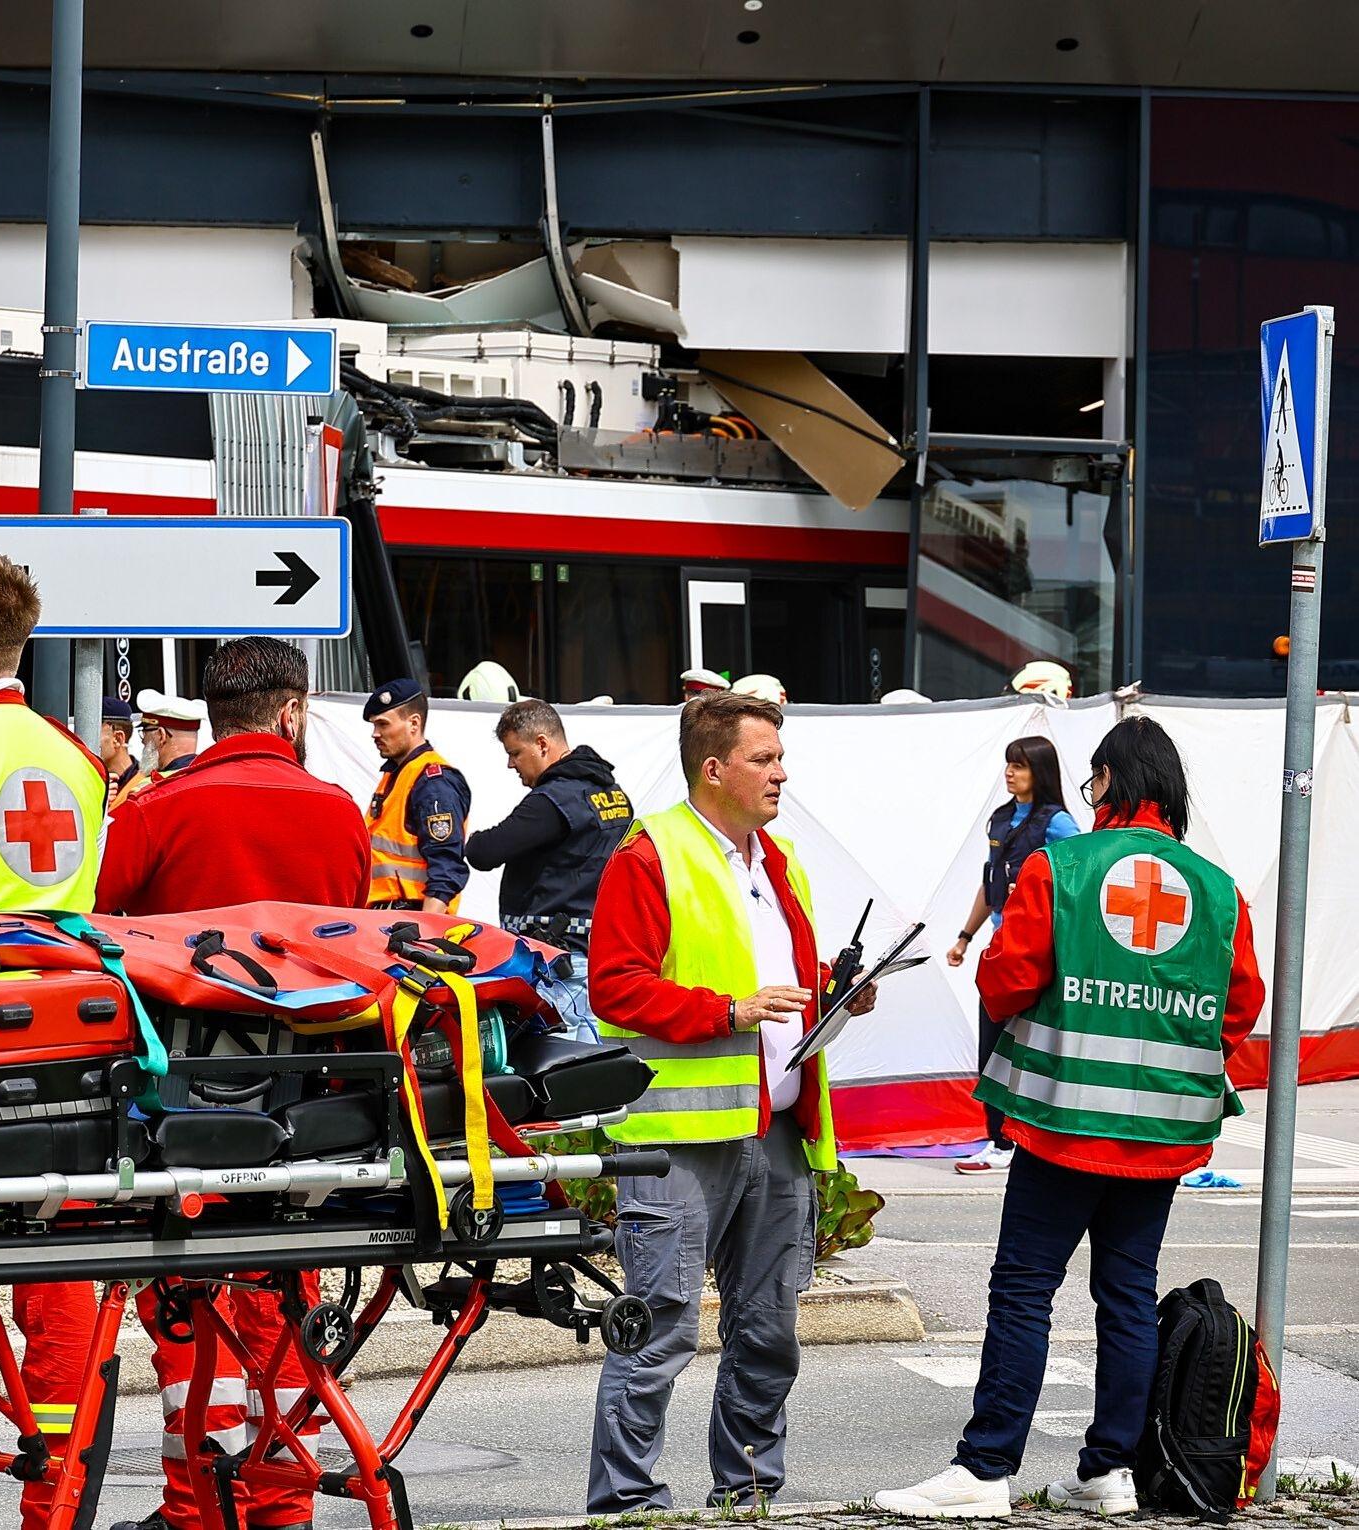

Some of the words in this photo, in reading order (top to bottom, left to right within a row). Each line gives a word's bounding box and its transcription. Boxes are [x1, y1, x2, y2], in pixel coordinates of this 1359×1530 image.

[112, 337, 270, 376] Austraße
[1063, 976, 1217, 1021] BETREUUNG
[368, 1230, 416, 1244] MONDIAL
